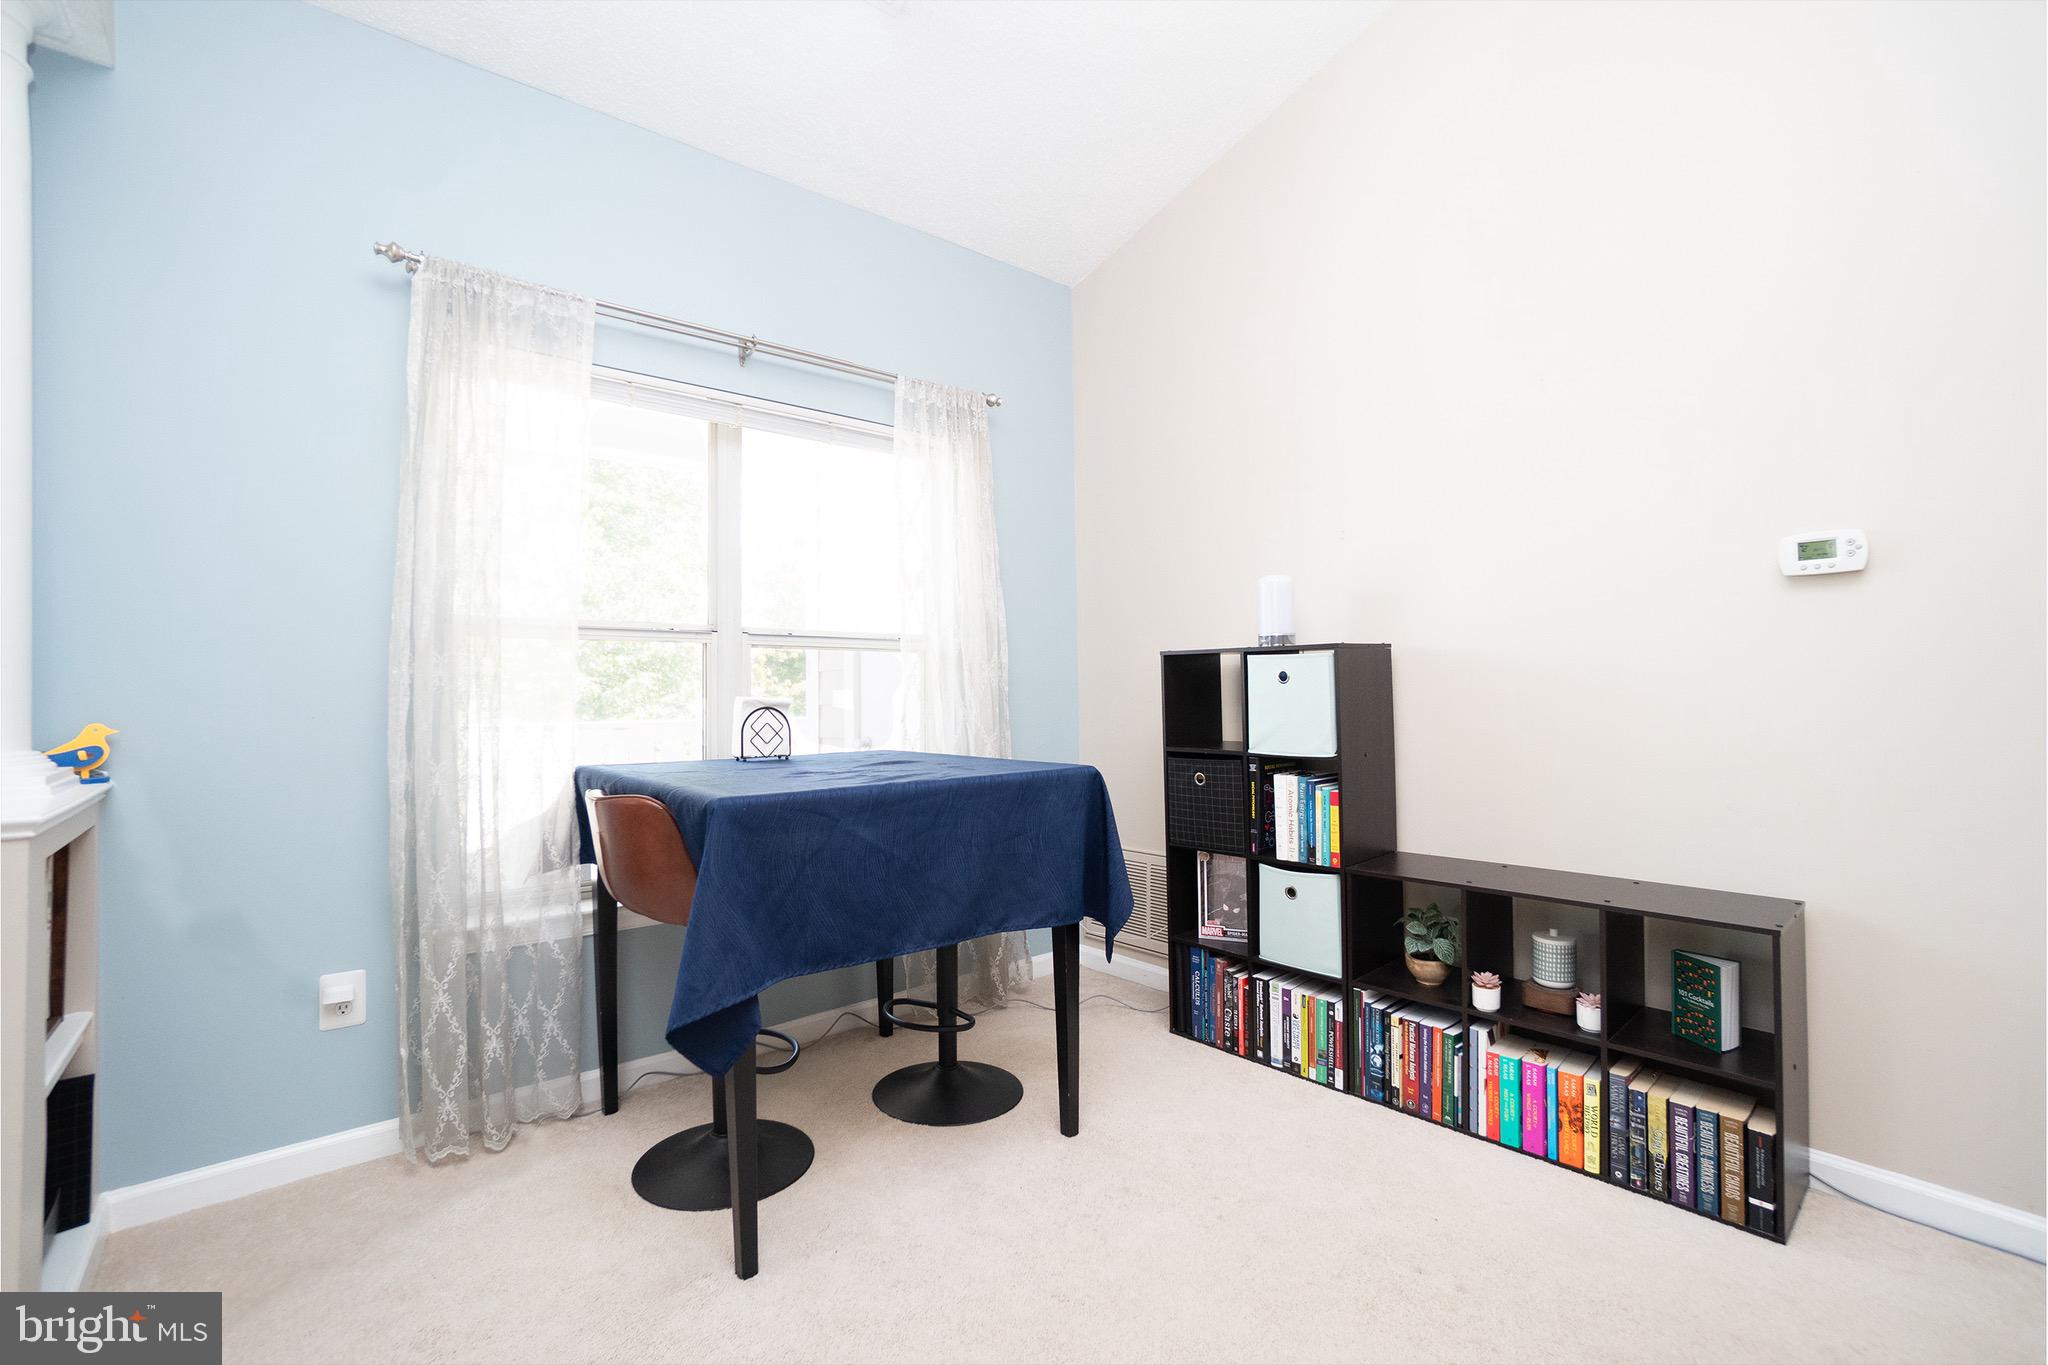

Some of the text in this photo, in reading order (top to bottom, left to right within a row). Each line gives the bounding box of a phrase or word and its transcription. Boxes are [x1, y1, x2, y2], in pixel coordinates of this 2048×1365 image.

[1288, 819, 1296, 844] Habits
[1201, 926, 1223, 936] MARVEL
[1688, 993, 1715, 1007] Cocktails
[1224, 1008, 1233, 1037] Caste
[1408, 1062, 1416, 1081] Analysis
[1611, 1084, 1619, 1113] MARTIN
[1590, 1105, 1598, 1139] WORLD
[1674, 1116, 1689, 1152] BEAUTIFUL
[1699, 1120, 1714, 1158] BEAUTIFUL
[1723, 1132, 1739, 1173] BEAUTIFUL
[1654, 1162, 1666, 1191] Bones
[1675, 1152, 1690, 1192] CREATURES
[1700, 1157, 1715, 1195] DARKNESS
[1724, 1173, 1740, 1201] CHAOS
